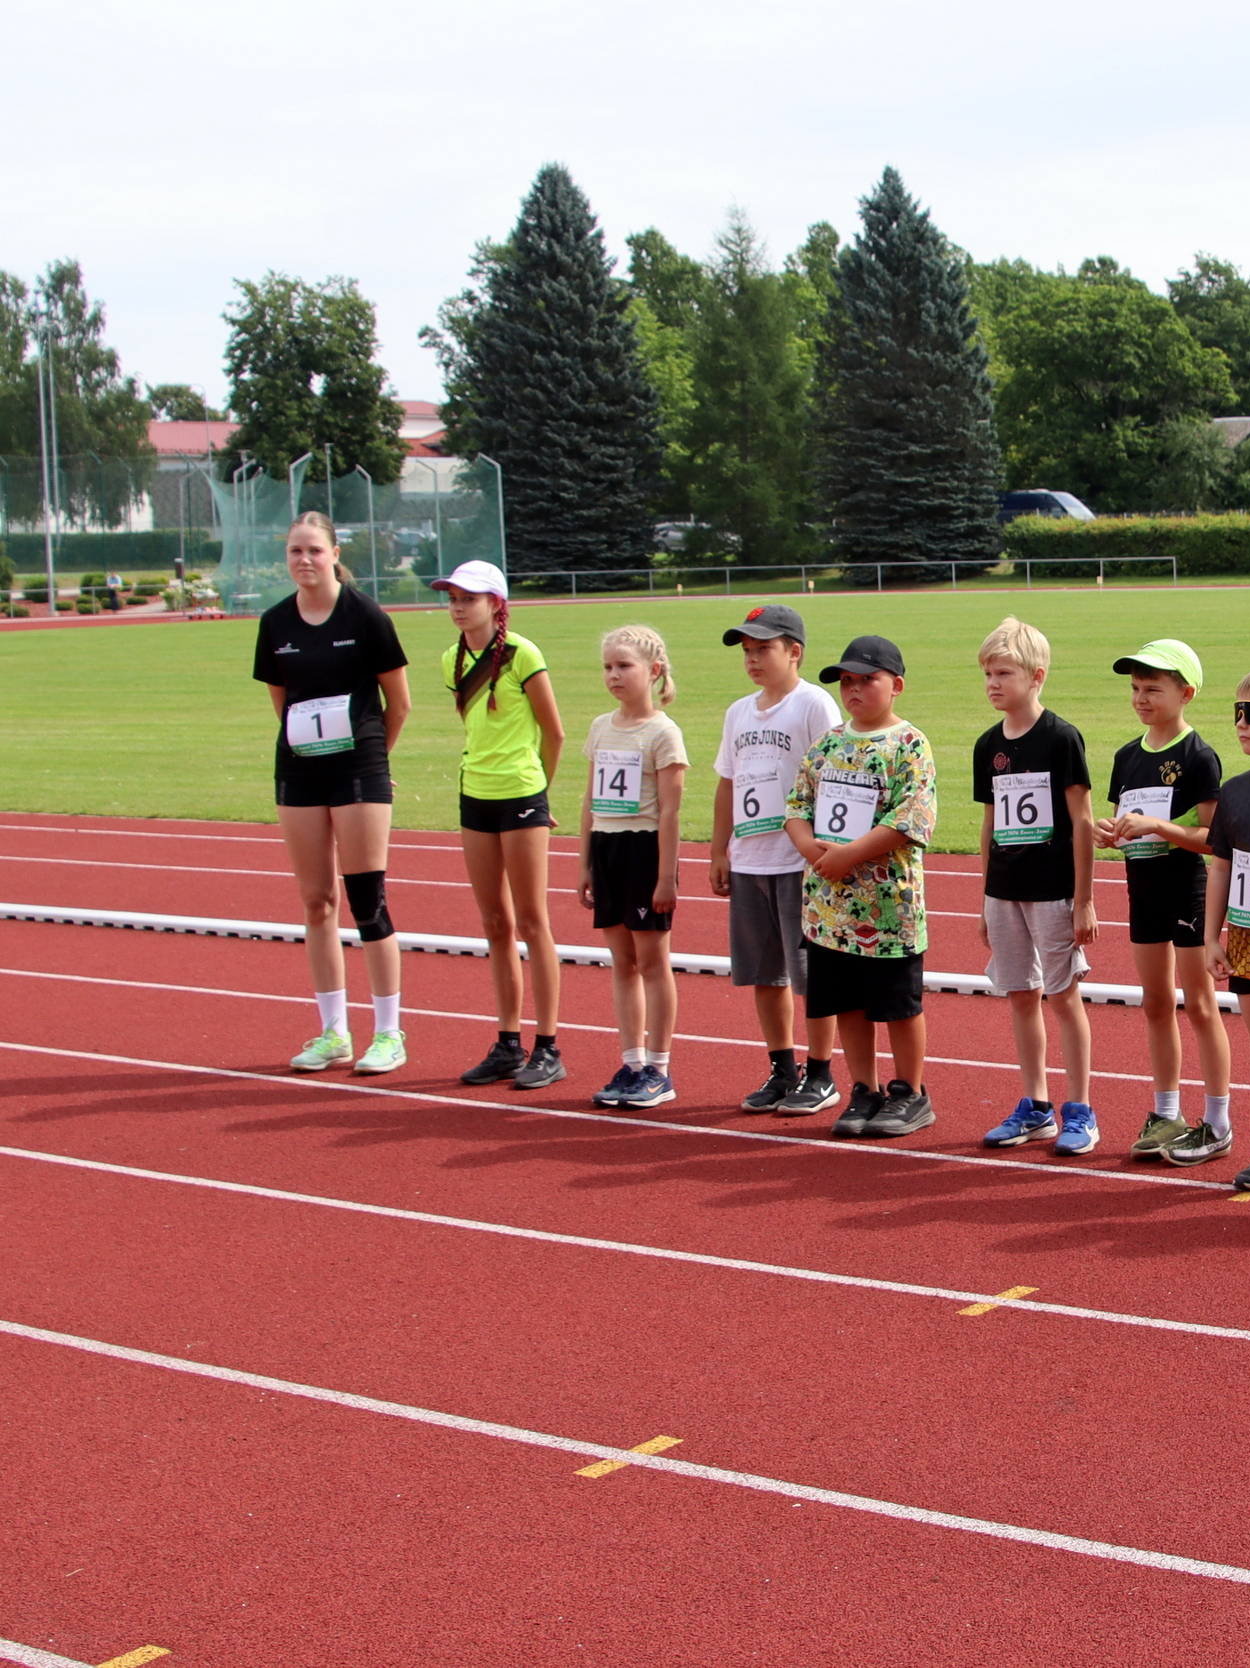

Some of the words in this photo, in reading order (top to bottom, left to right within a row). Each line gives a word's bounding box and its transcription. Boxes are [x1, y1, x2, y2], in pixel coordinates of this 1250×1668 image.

[311, 712, 323, 739] 1
[735, 730, 791, 757] CK&JONES
[598, 767, 628, 797] 14
[820, 769, 887, 789] MINECRAFT
[743, 787, 760, 818] 6
[828, 802, 848, 833] 8
[1001, 792, 1038, 826] 16
